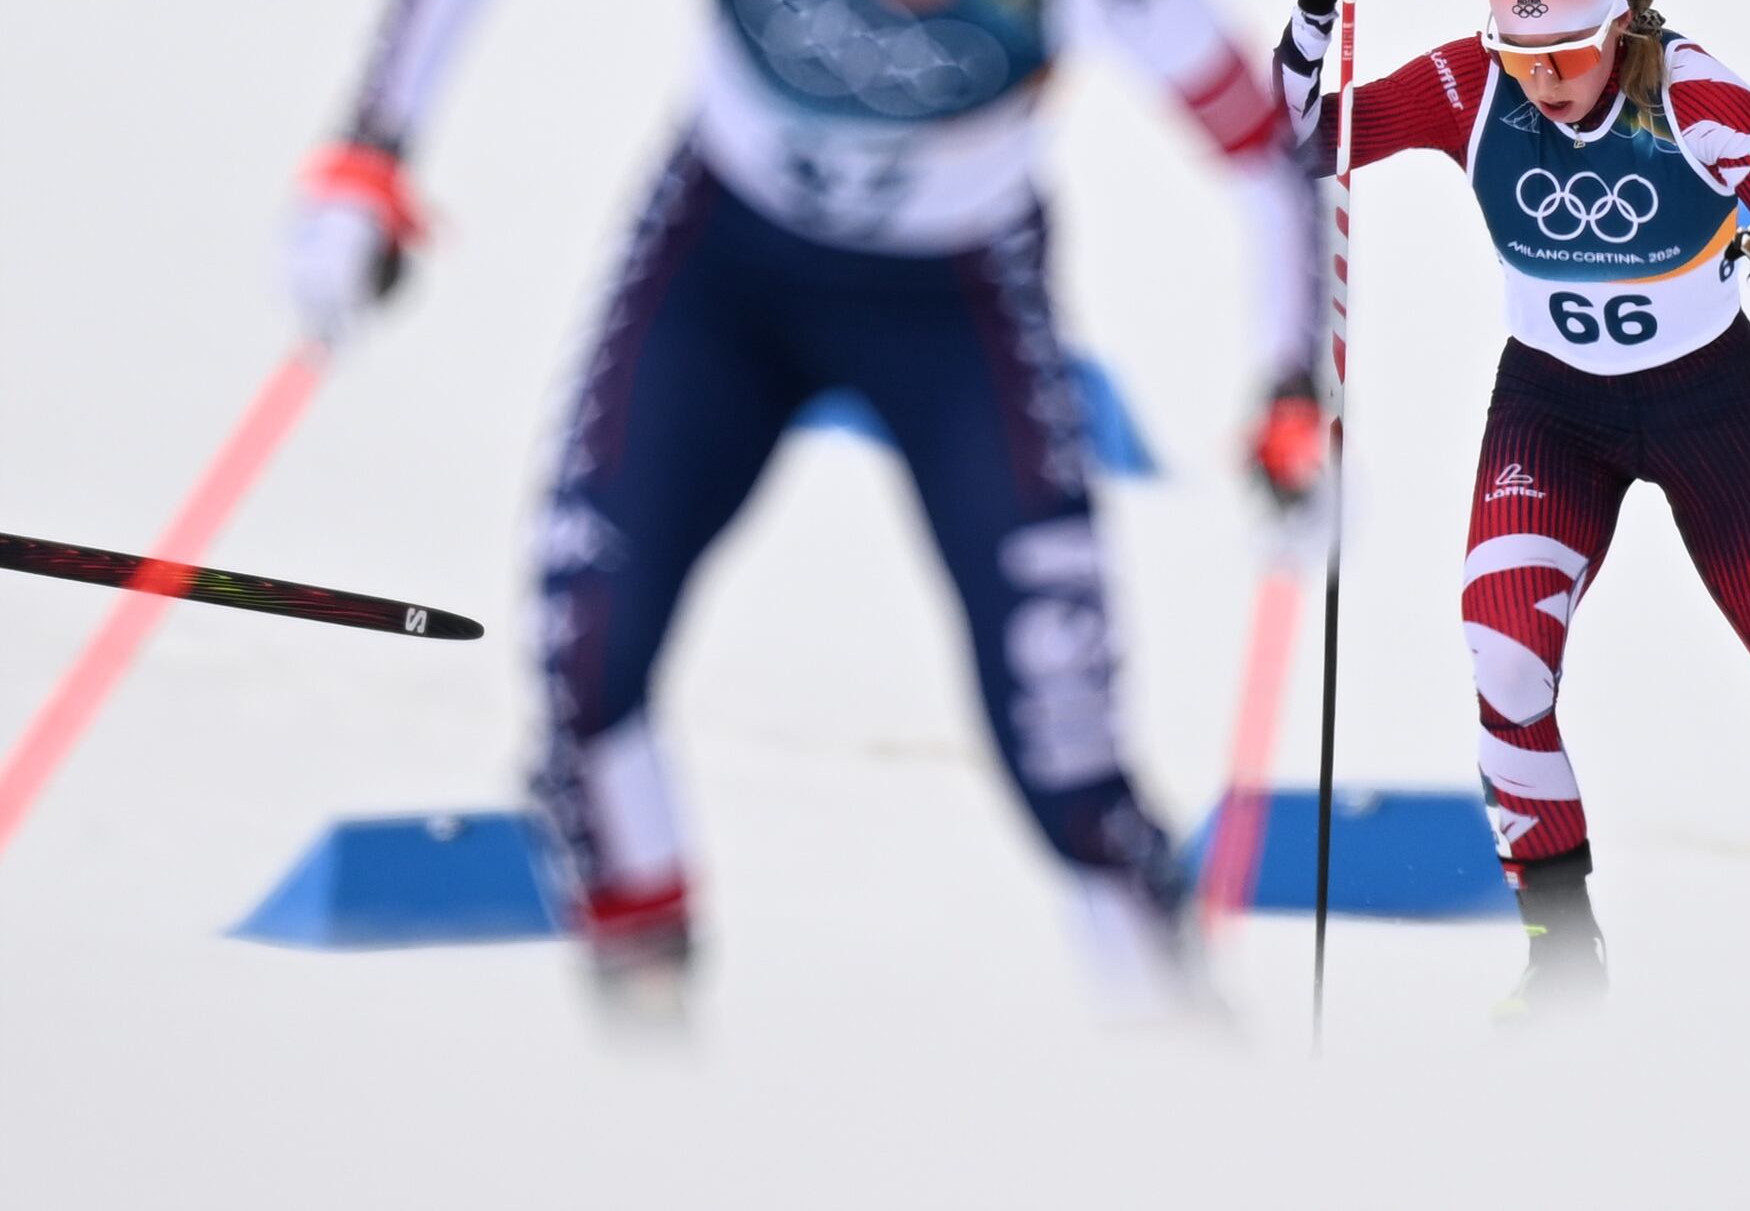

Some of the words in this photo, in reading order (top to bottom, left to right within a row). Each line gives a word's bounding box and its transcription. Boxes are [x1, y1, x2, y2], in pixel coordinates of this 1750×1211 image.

[1507, 240, 1570, 261] MILANO
[1572, 250, 1645, 265] CORTINA
[1648, 245, 1681, 264] 2026
[1548, 290, 1659, 346] 66
